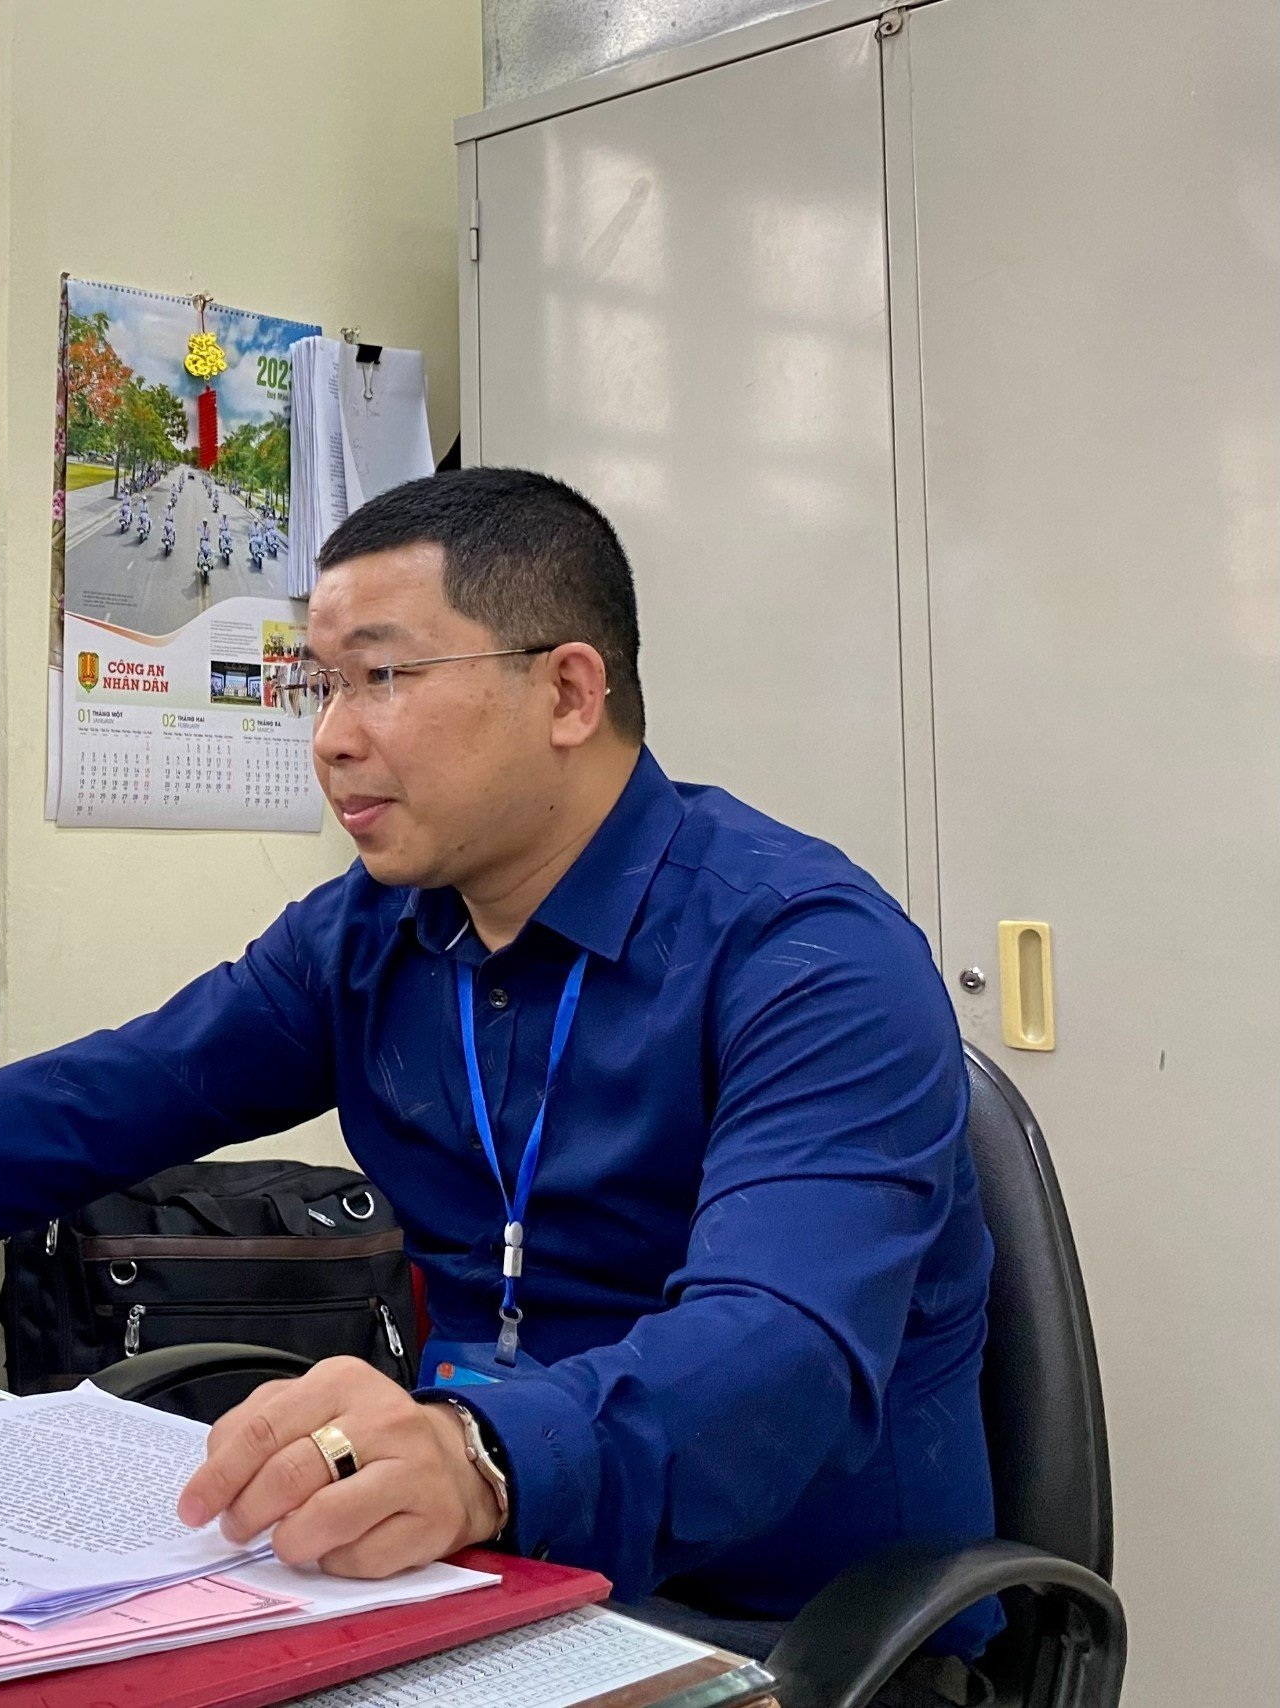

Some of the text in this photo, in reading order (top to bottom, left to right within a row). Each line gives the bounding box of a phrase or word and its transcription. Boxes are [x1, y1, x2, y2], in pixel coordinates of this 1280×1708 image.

[256, 356, 292, 391] 202
[107, 660, 165, 677] CÔNG AN
[103, 675, 169, 693] NHÂN DÂN
[78, 708, 91, 723] 01
[162, 713, 176, 728] 02
[242, 718, 255, 732] 03
